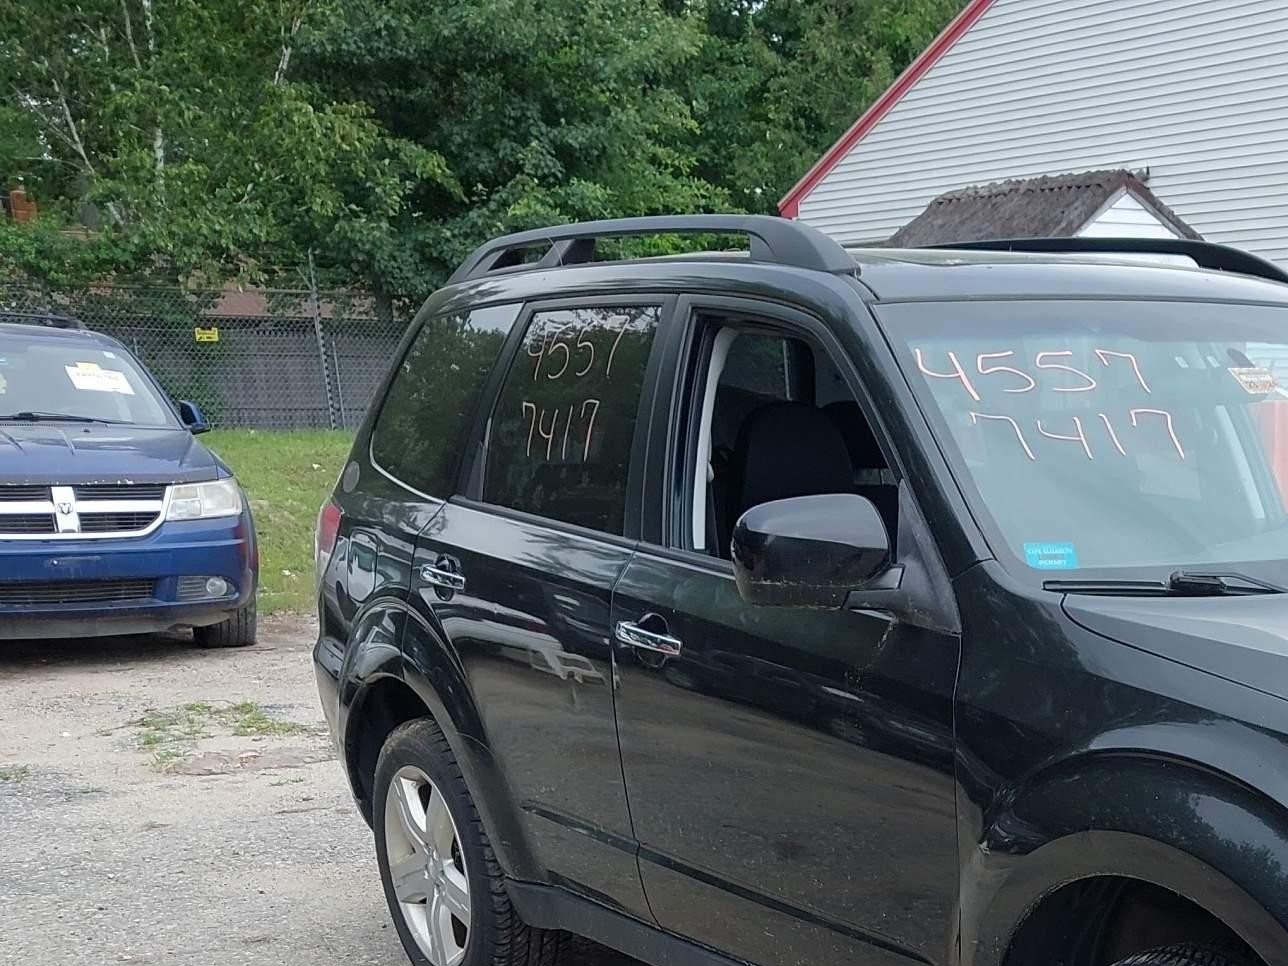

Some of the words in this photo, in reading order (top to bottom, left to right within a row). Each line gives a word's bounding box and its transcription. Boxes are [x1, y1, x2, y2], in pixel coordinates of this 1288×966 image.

[526, 314, 631, 381] 4557
[914, 347, 1152, 401] 4557
[521, 399, 600, 462] 7417
[968, 407, 1186, 461] 7417
